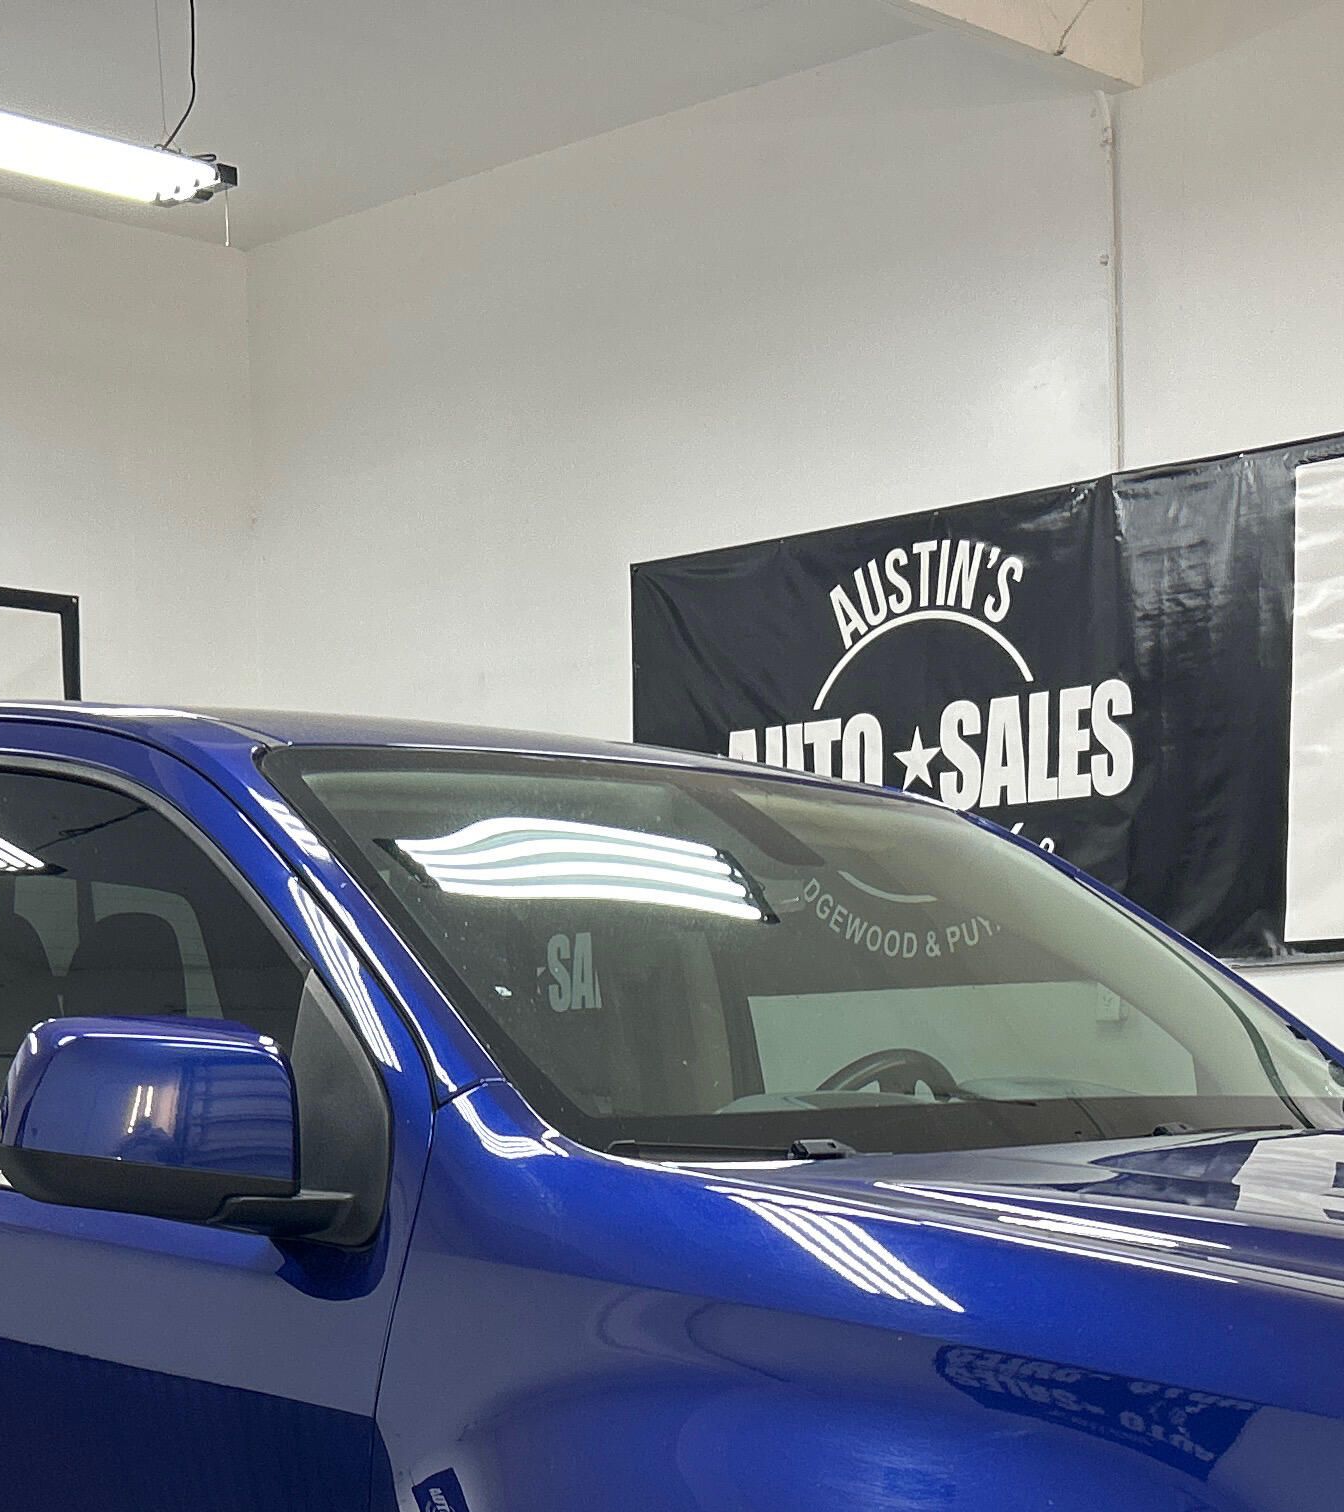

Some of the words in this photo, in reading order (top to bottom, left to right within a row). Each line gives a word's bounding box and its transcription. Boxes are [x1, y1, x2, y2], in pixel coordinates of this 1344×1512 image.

[828, 538, 1024, 649] AUSTIN'S
[729, 713, 883, 787] TO
[939, 679, 1134, 811] SALES
[947, 915, 1002, 955] PUY
